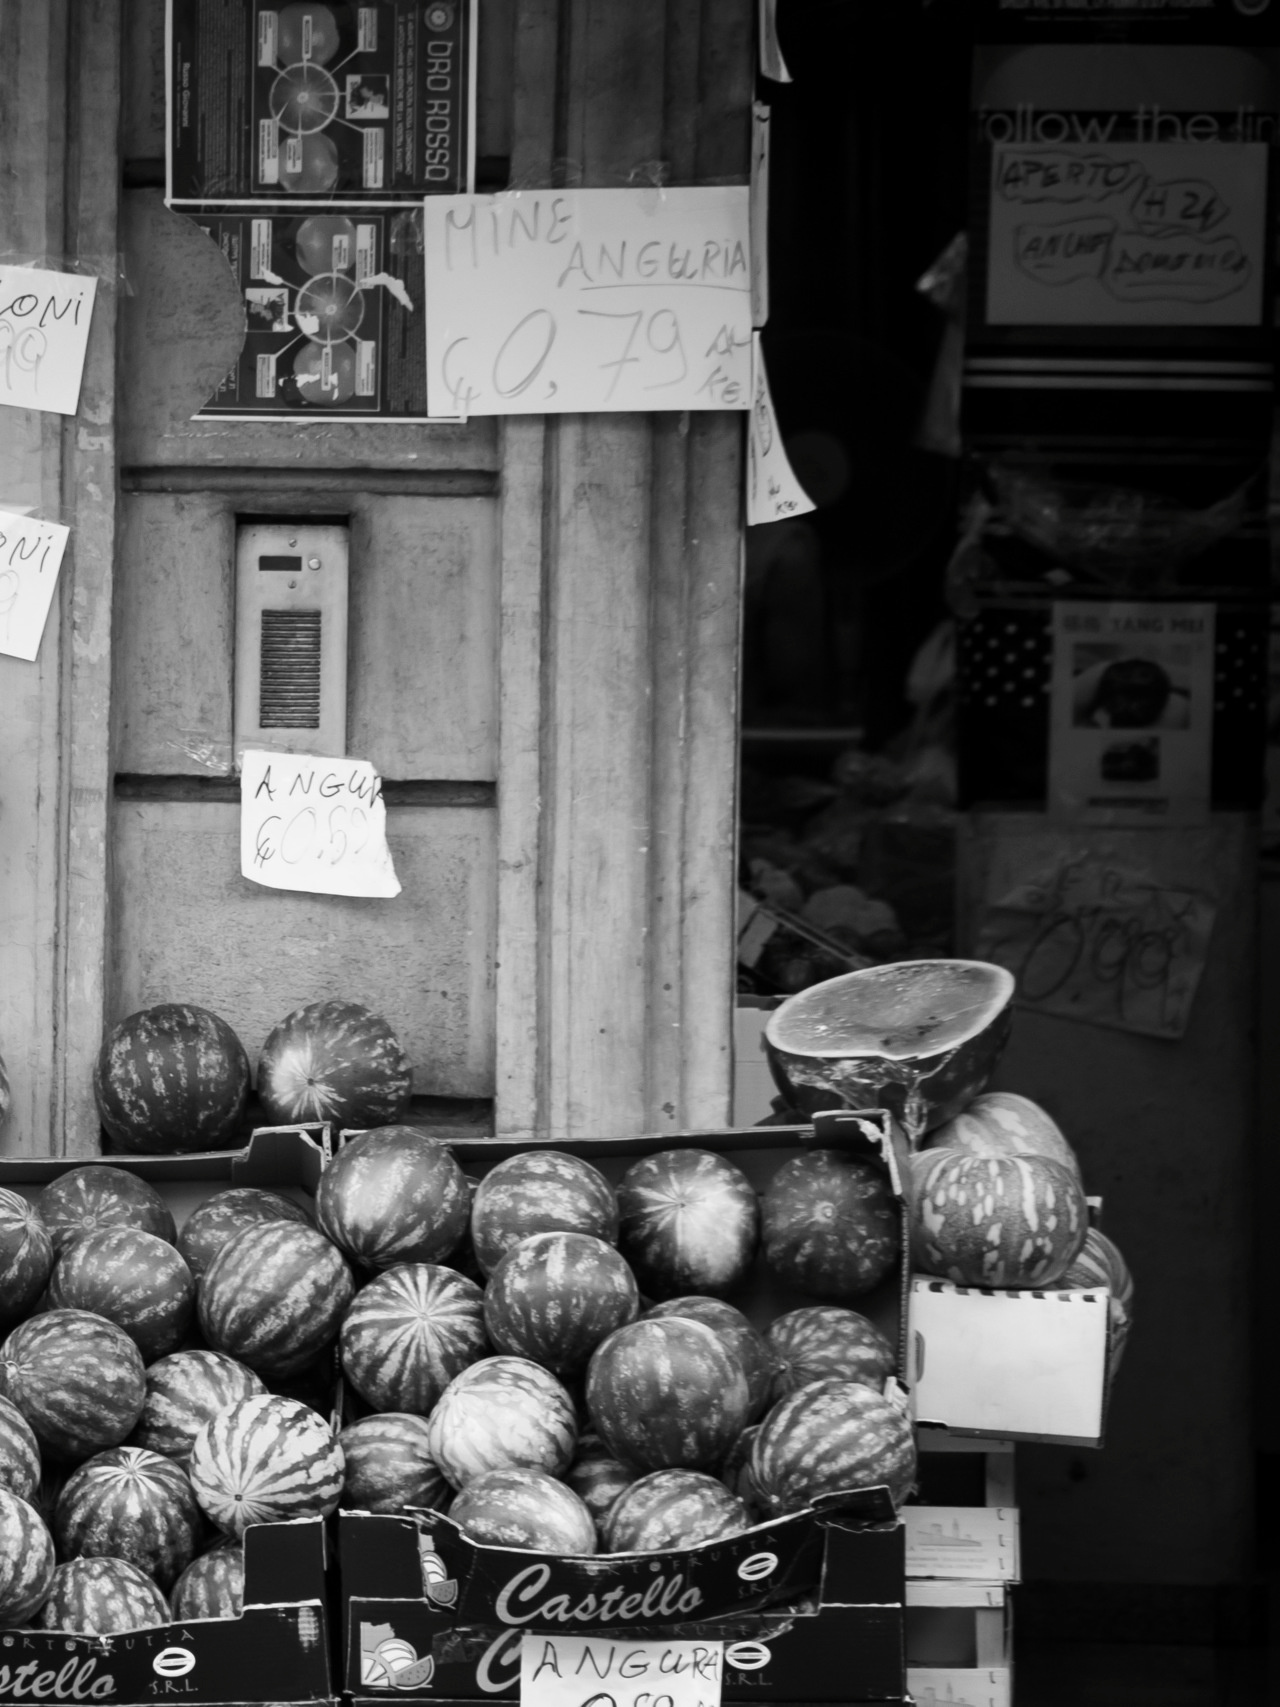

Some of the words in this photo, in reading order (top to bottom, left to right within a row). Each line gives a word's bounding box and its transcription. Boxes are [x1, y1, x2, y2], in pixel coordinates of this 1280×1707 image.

[182, 62, 191, 88] Russo
[426, 41, 453, 91] ORO
[182, 89, 191, 128] Giovanni
[978, 102, 1118, 144] follow
[1132, 102, 1220, 144] the
[1236, 103, 1280, 144] lin
[424, 98, 451, 182] ROSSO
[1003, 160, 1131, 188] APERTO
[445, 198, 573, 272] MINE
[556, 239, 748, 289] ANGURIA
[495, 1562, 705, 1625] Castello
